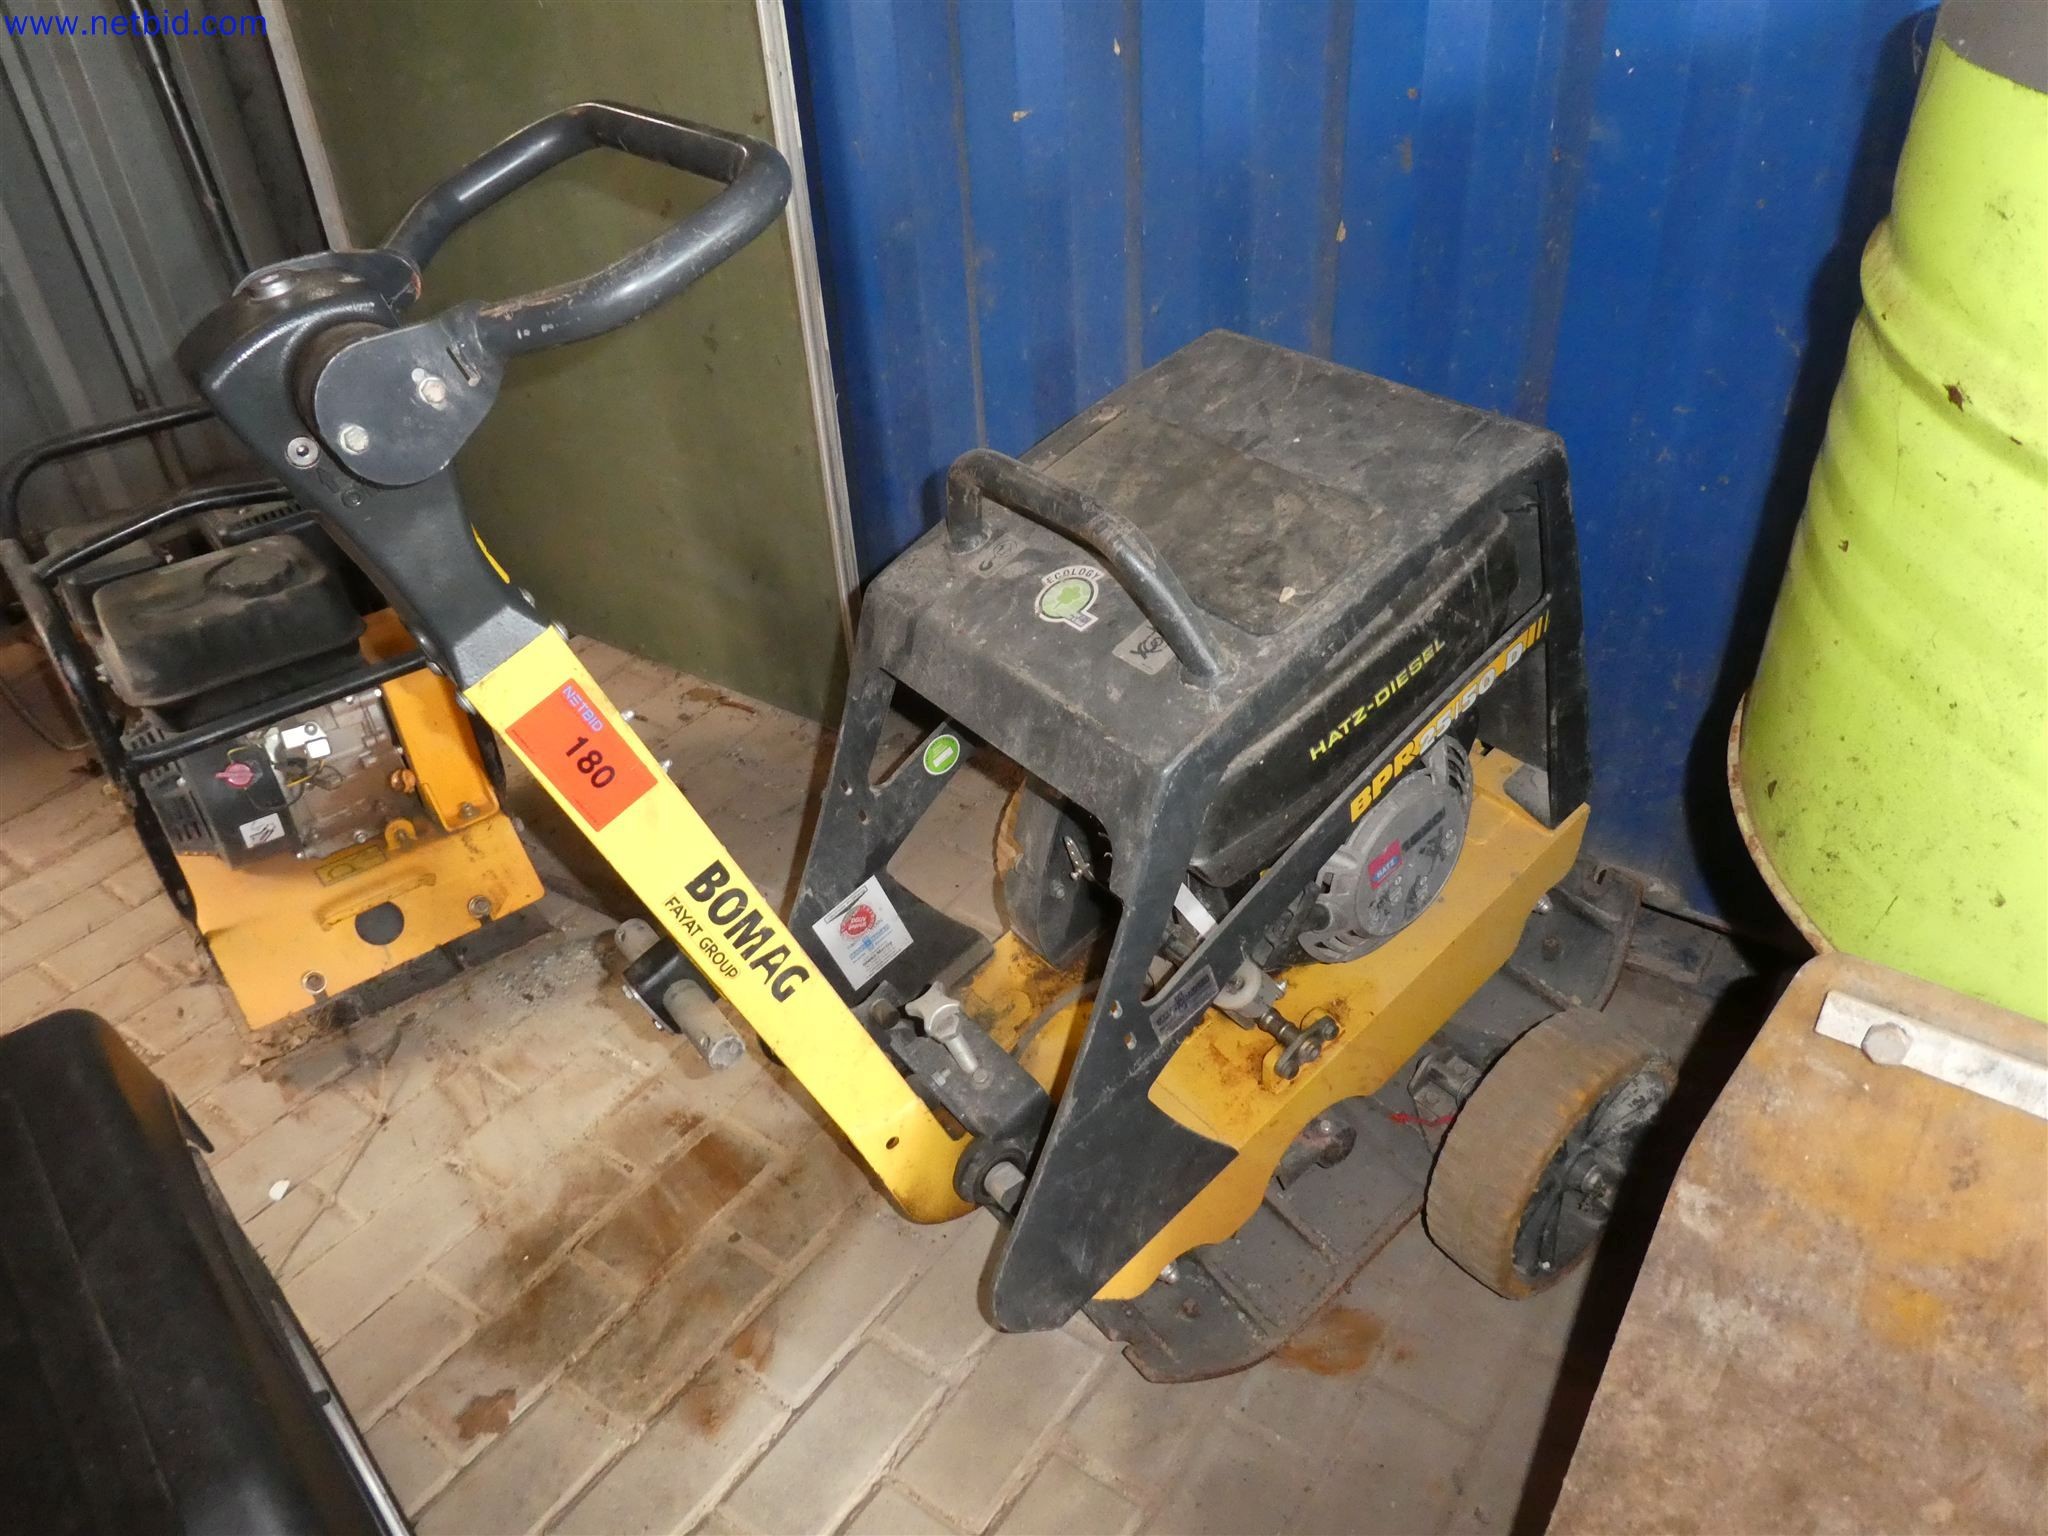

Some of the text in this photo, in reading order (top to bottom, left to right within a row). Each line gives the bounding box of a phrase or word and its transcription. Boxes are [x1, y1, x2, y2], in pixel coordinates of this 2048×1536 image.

[1046, 567, 1100, 584] ECOLOGY
[562, 685, 604, 732] NETBID
[1309, 638, 1446, 761] HATZ-DIESEL
[566, 736, 616, 789] 180
[665, 896, 739, 978] FAYAT GROUP
[684, 859, 810, 1003] BOMAG
